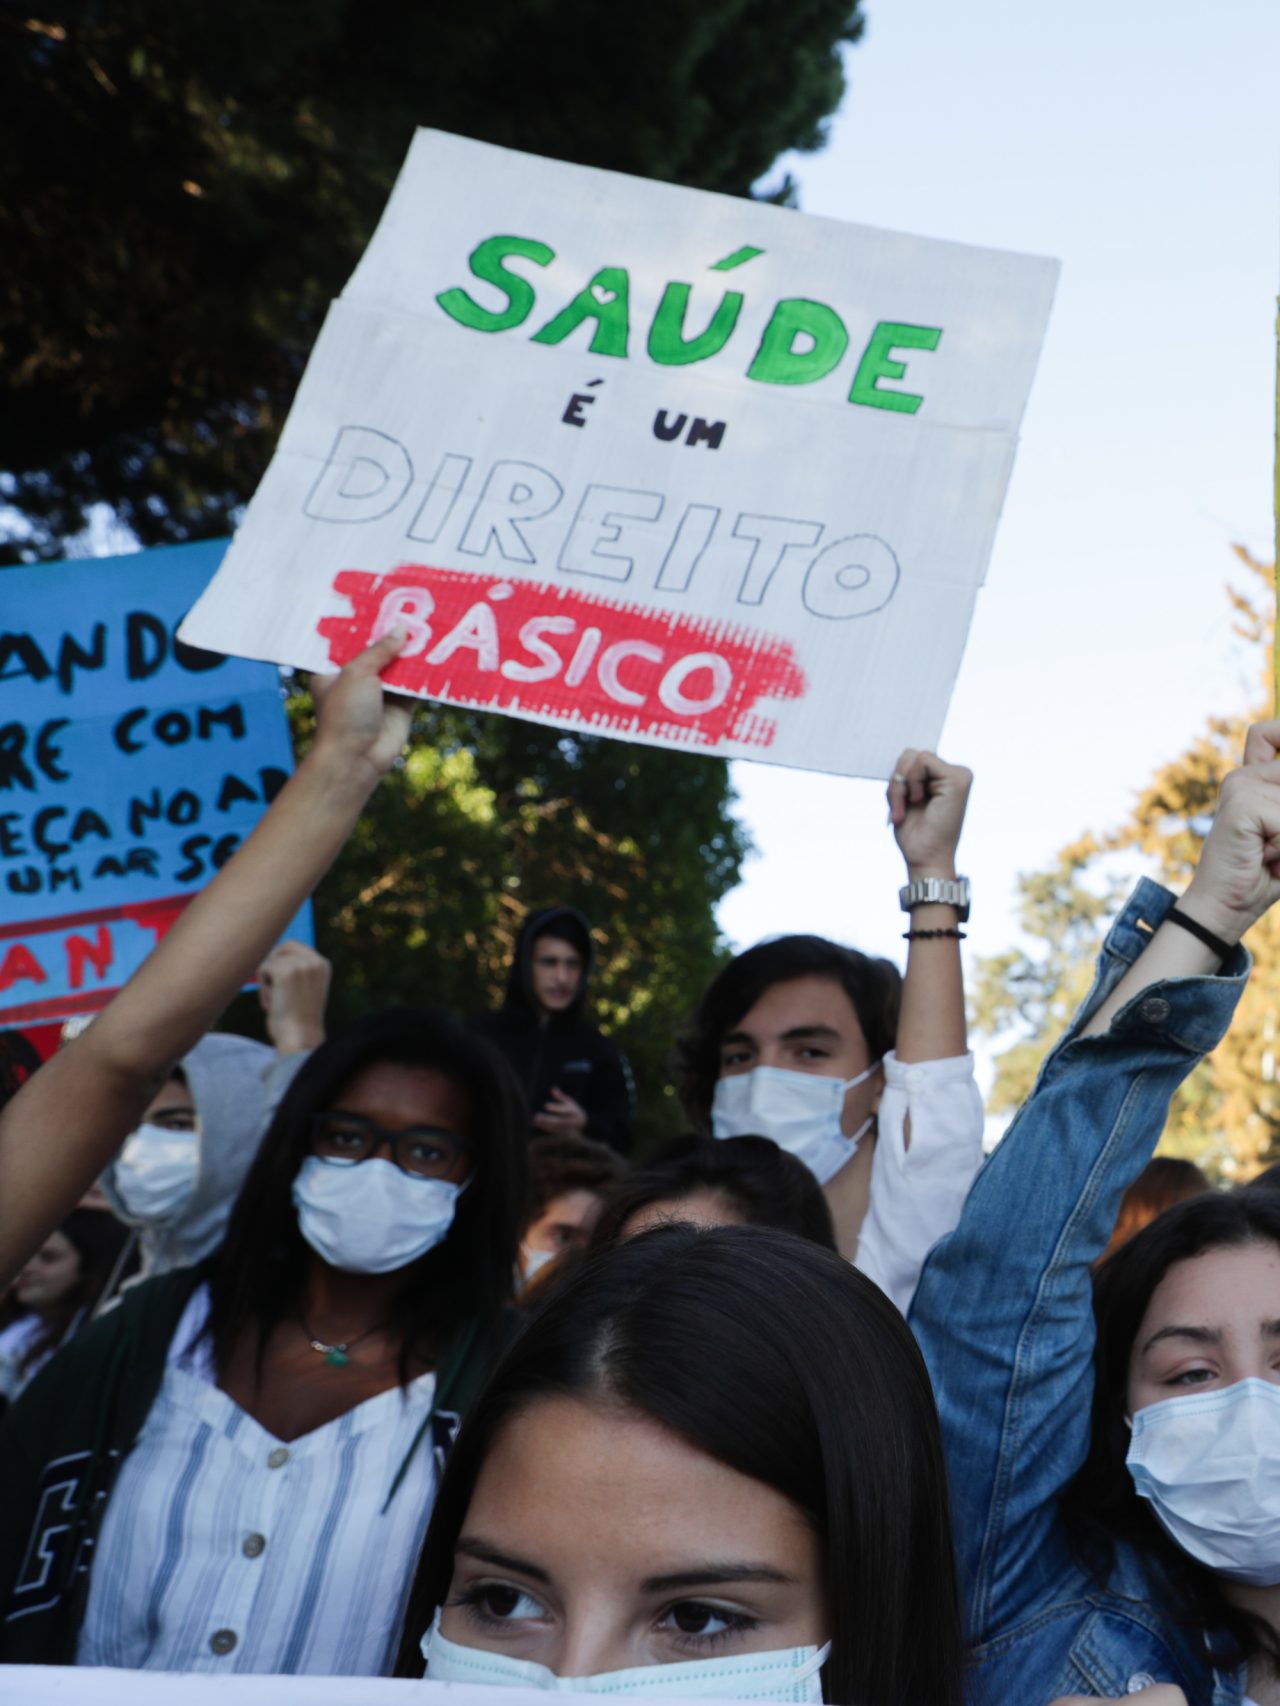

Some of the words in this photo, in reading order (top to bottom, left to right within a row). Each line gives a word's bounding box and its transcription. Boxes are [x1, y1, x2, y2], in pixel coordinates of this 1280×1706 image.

[436, 236, 943, 414] SAÚDE
[561, 379, 604, 427] É
[653, 409, 727, 449] UM
[304, 426, 901, 620] DIREITO
[366, 586, 733, 715] BÁSICO
[114, 702, 245, 755] COM
[129, 788, 201, 838] NO
[6, 864, 82, 894] UM
